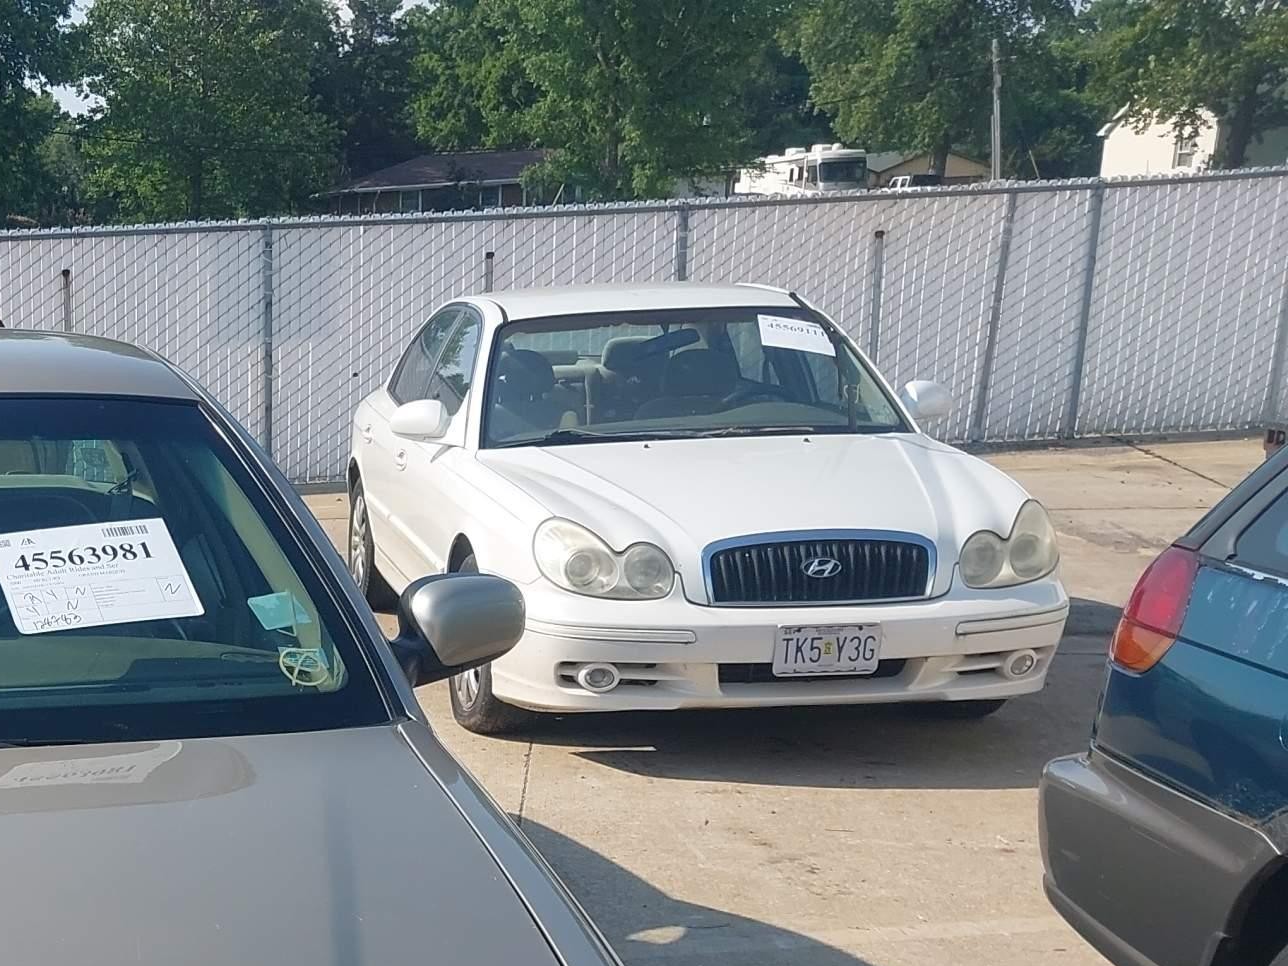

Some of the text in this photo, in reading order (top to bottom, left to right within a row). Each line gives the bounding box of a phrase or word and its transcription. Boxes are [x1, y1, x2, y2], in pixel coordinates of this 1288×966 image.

[14, 541, 154, 571] 45563981
[782, 635, 876, 664] TK5 Y3G
